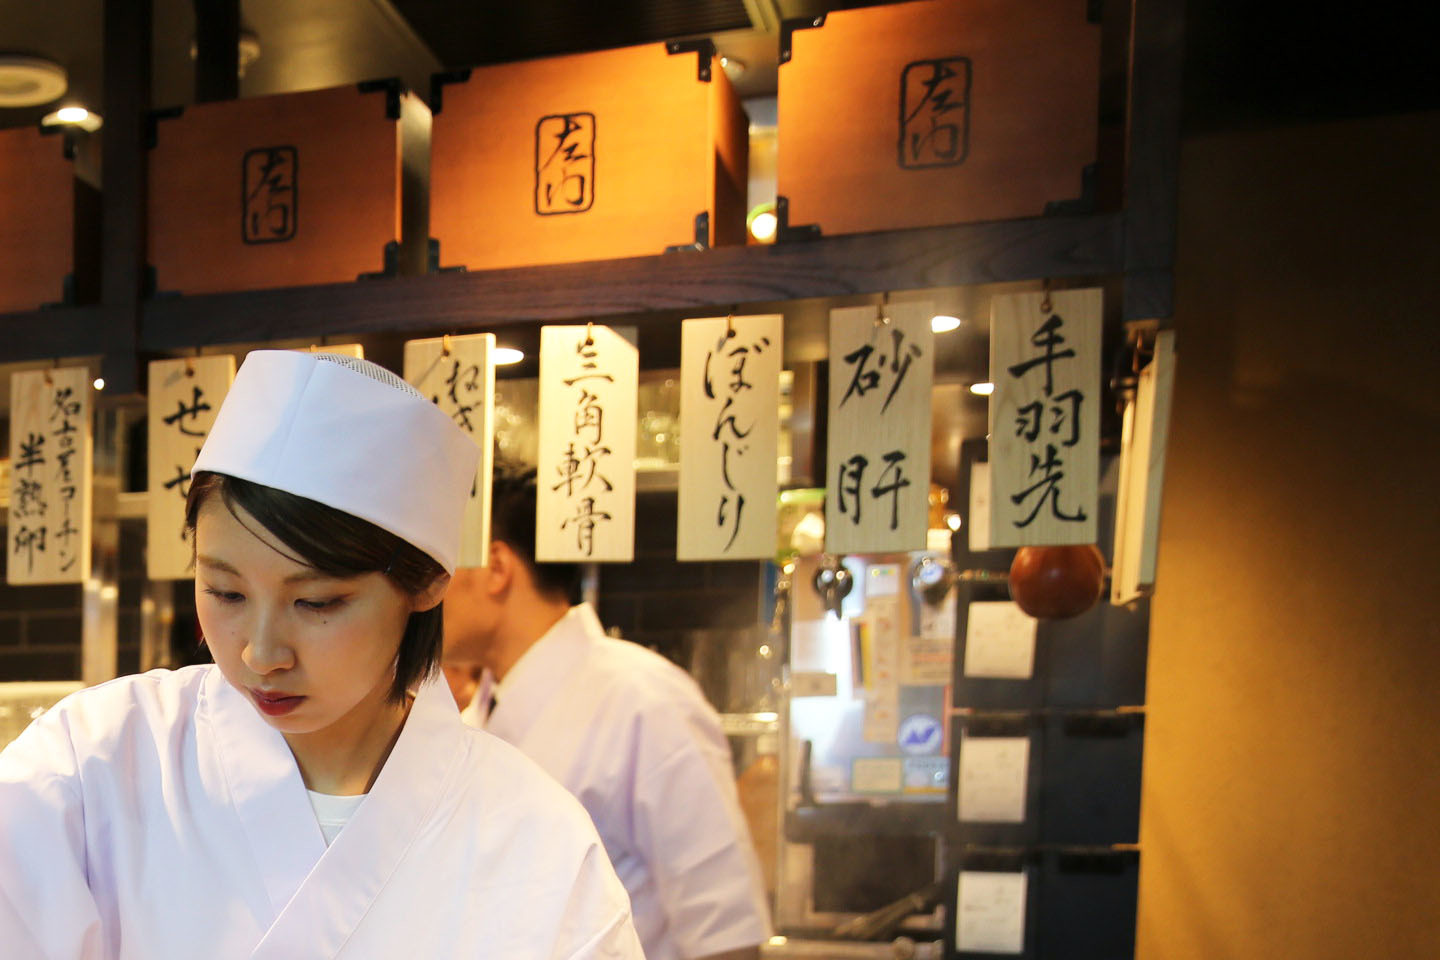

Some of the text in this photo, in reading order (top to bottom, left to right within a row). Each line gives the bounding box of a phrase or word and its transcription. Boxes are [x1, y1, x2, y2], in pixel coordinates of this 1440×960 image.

[49, 386, 82, 573] 名古屋コーチン
[552, 349, 614, 557] 三角軟骨
[704, 337, 771, 552] ぼんじり
[838, 329, 922, 531] 砂肝
[1009, 314, 1088, 529] 手羽先
